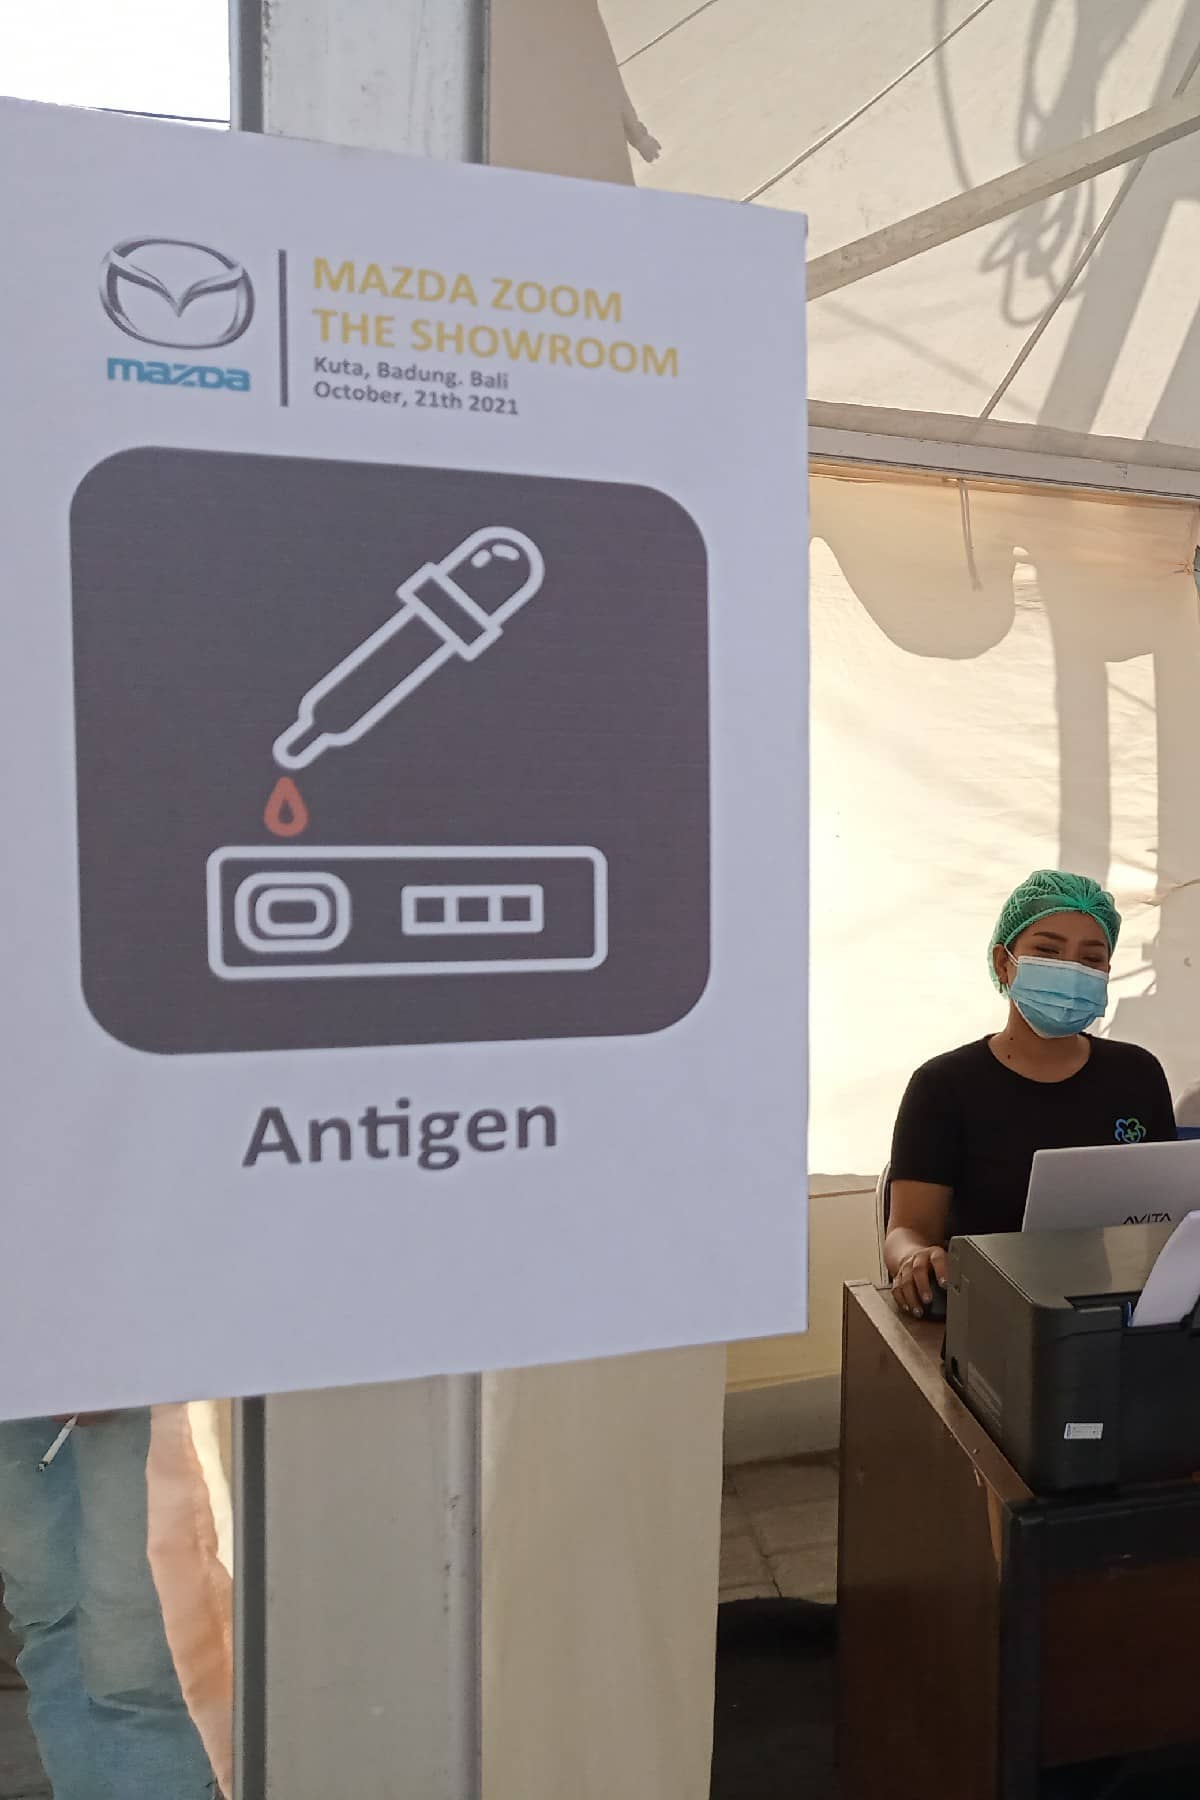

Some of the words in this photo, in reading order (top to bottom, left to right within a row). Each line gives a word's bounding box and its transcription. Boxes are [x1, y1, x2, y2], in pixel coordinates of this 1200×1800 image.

[312, 258, 478, 306] MAZDA
[491, 278, 622, 322] ZOOM
[312, 308, 396, 348] THE
[410, 319, 679, 378] SHOWROOM
[314, 357, 371, 380] Kuta,
[470, 368, 509, 390] Bali
[314, 382, 408, 407] October,
[415, 388, 463, 411] 21th
[470, 392, 519, 415] 2021
[242, 1096, 558, 1171] Antigen
[1123, 1212, 1172, 1225] AVITA
